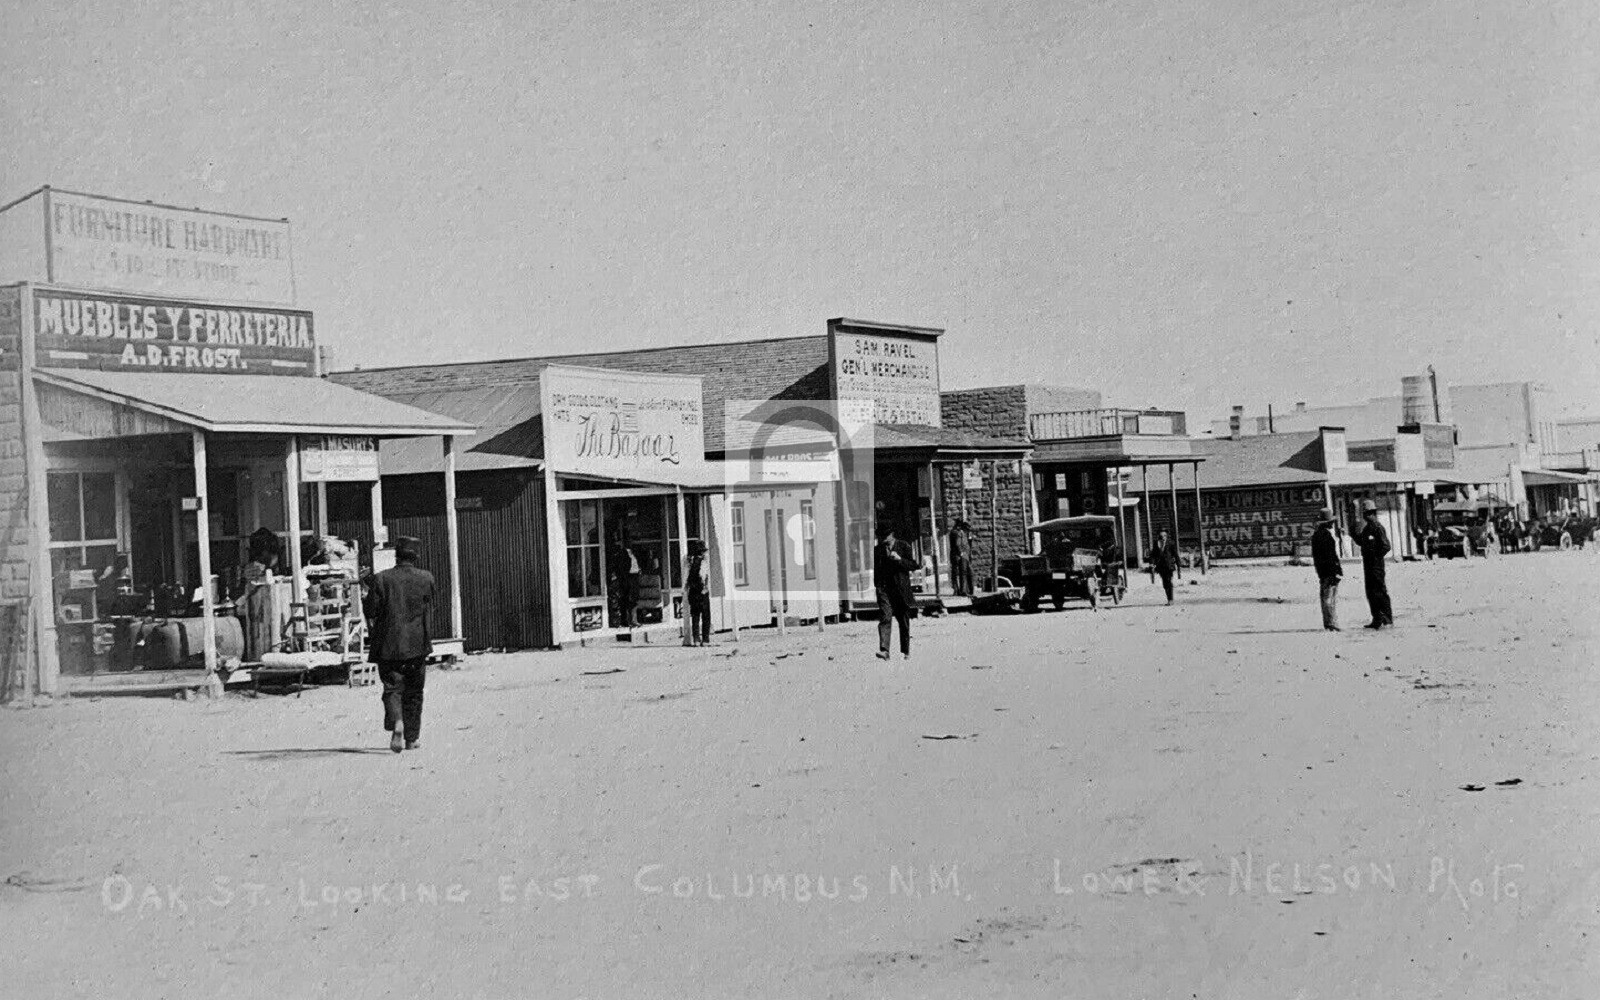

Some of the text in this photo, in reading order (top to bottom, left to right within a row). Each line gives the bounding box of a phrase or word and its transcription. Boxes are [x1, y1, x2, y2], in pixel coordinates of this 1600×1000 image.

[53, 203, 284, 261] FURNITURE HARDWARE
[39, 297, 158, 341] MUEBLES
[162, 305, 184, 342] Y
[855, 339, 916, 359] SAM RAVEL
[871, 362, 931, 380] MERCHANDISE
[1202, 521, 1315, 543] TOWN LOTS
